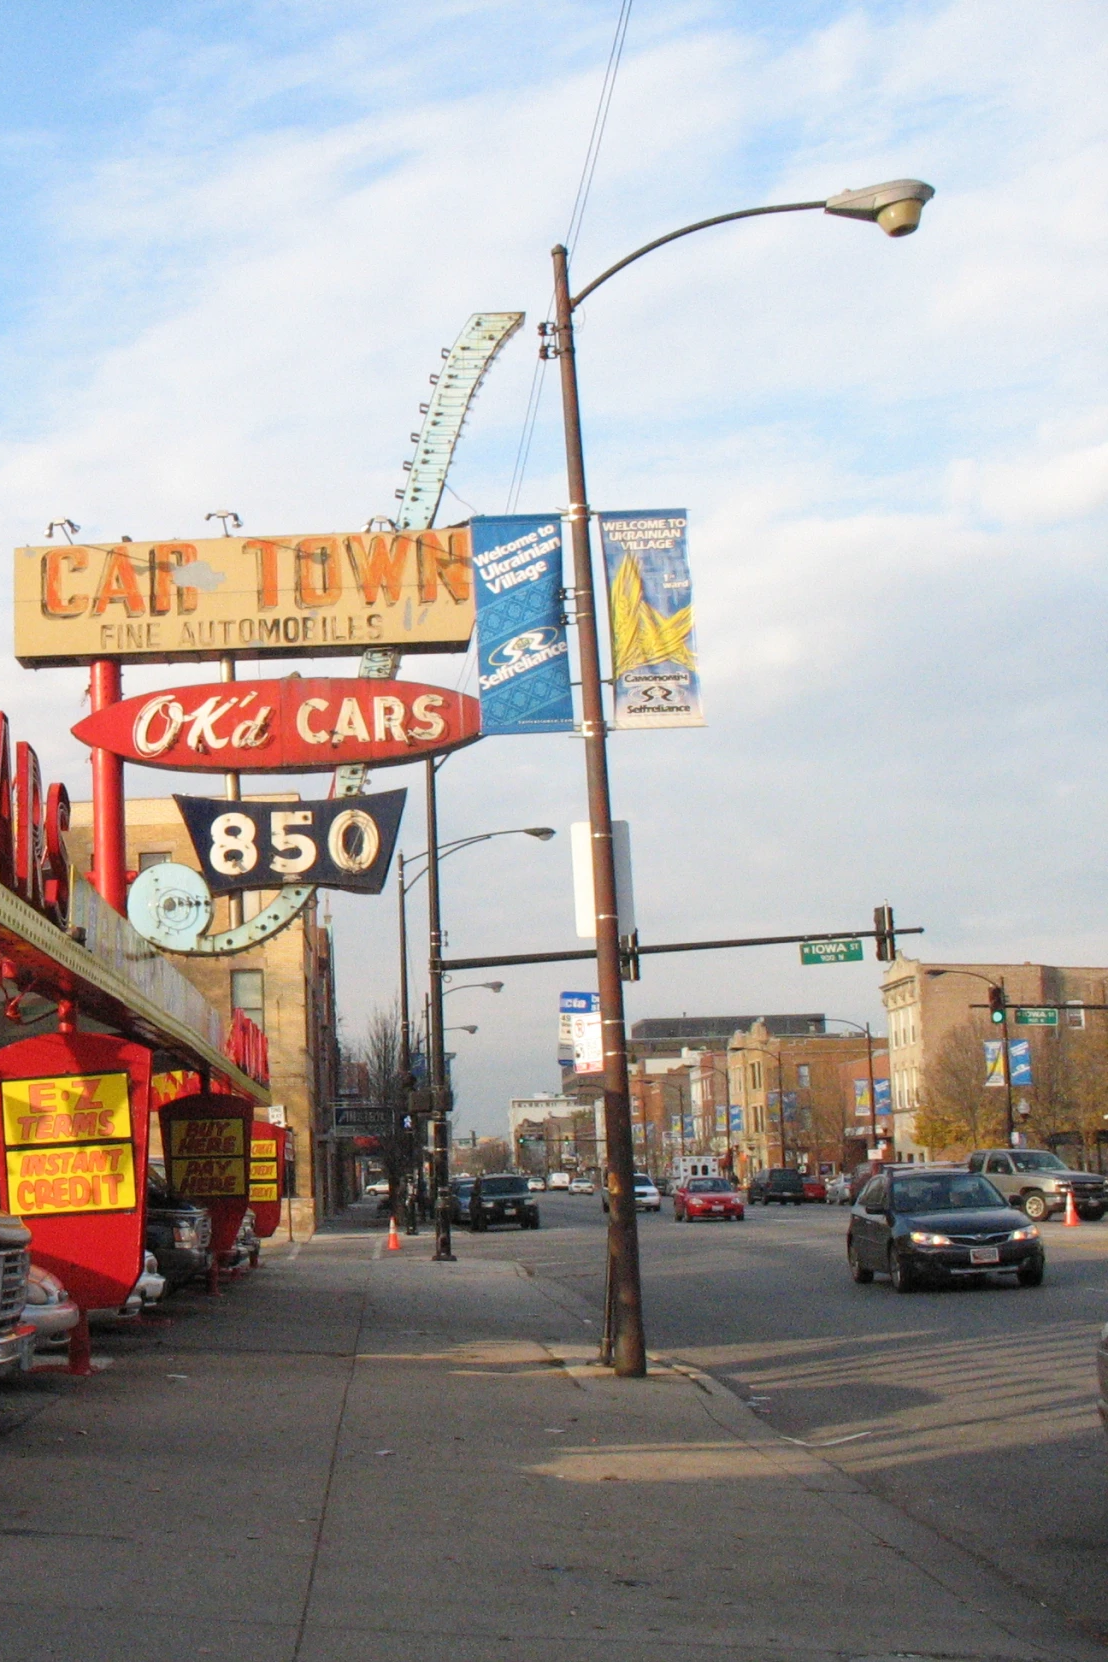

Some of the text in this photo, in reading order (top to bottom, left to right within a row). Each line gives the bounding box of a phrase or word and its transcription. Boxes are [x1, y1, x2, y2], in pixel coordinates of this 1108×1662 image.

[602, 518, 687, 532] WELCOME TO
[608, 528, 682, 541] UKRAINIAN
[472, 524, 555, 567] Welcome to
[479, 536, 561, 581] Ukrainian
[620, 538, 675, 551] VILLAGE
[242, 528, 471, 611] TOWN
[485, 560, 547, 594] Village
[100, 612, 385, 649] FINE AUTOMOBILES
[479, 641, 568, 690] Selfreliance
[295, 694, 450, 747] CARS
[627, 704, 690, 714] Selfreliance
[209, 808, 381, 877] 850
[812, 943, 848, 955] IOWA
[17, 1109, 116, 1140] TERMS
[20, 1148, 124, 1178] INSTANT
[17, 1173, 125, 1211] CREDIT
